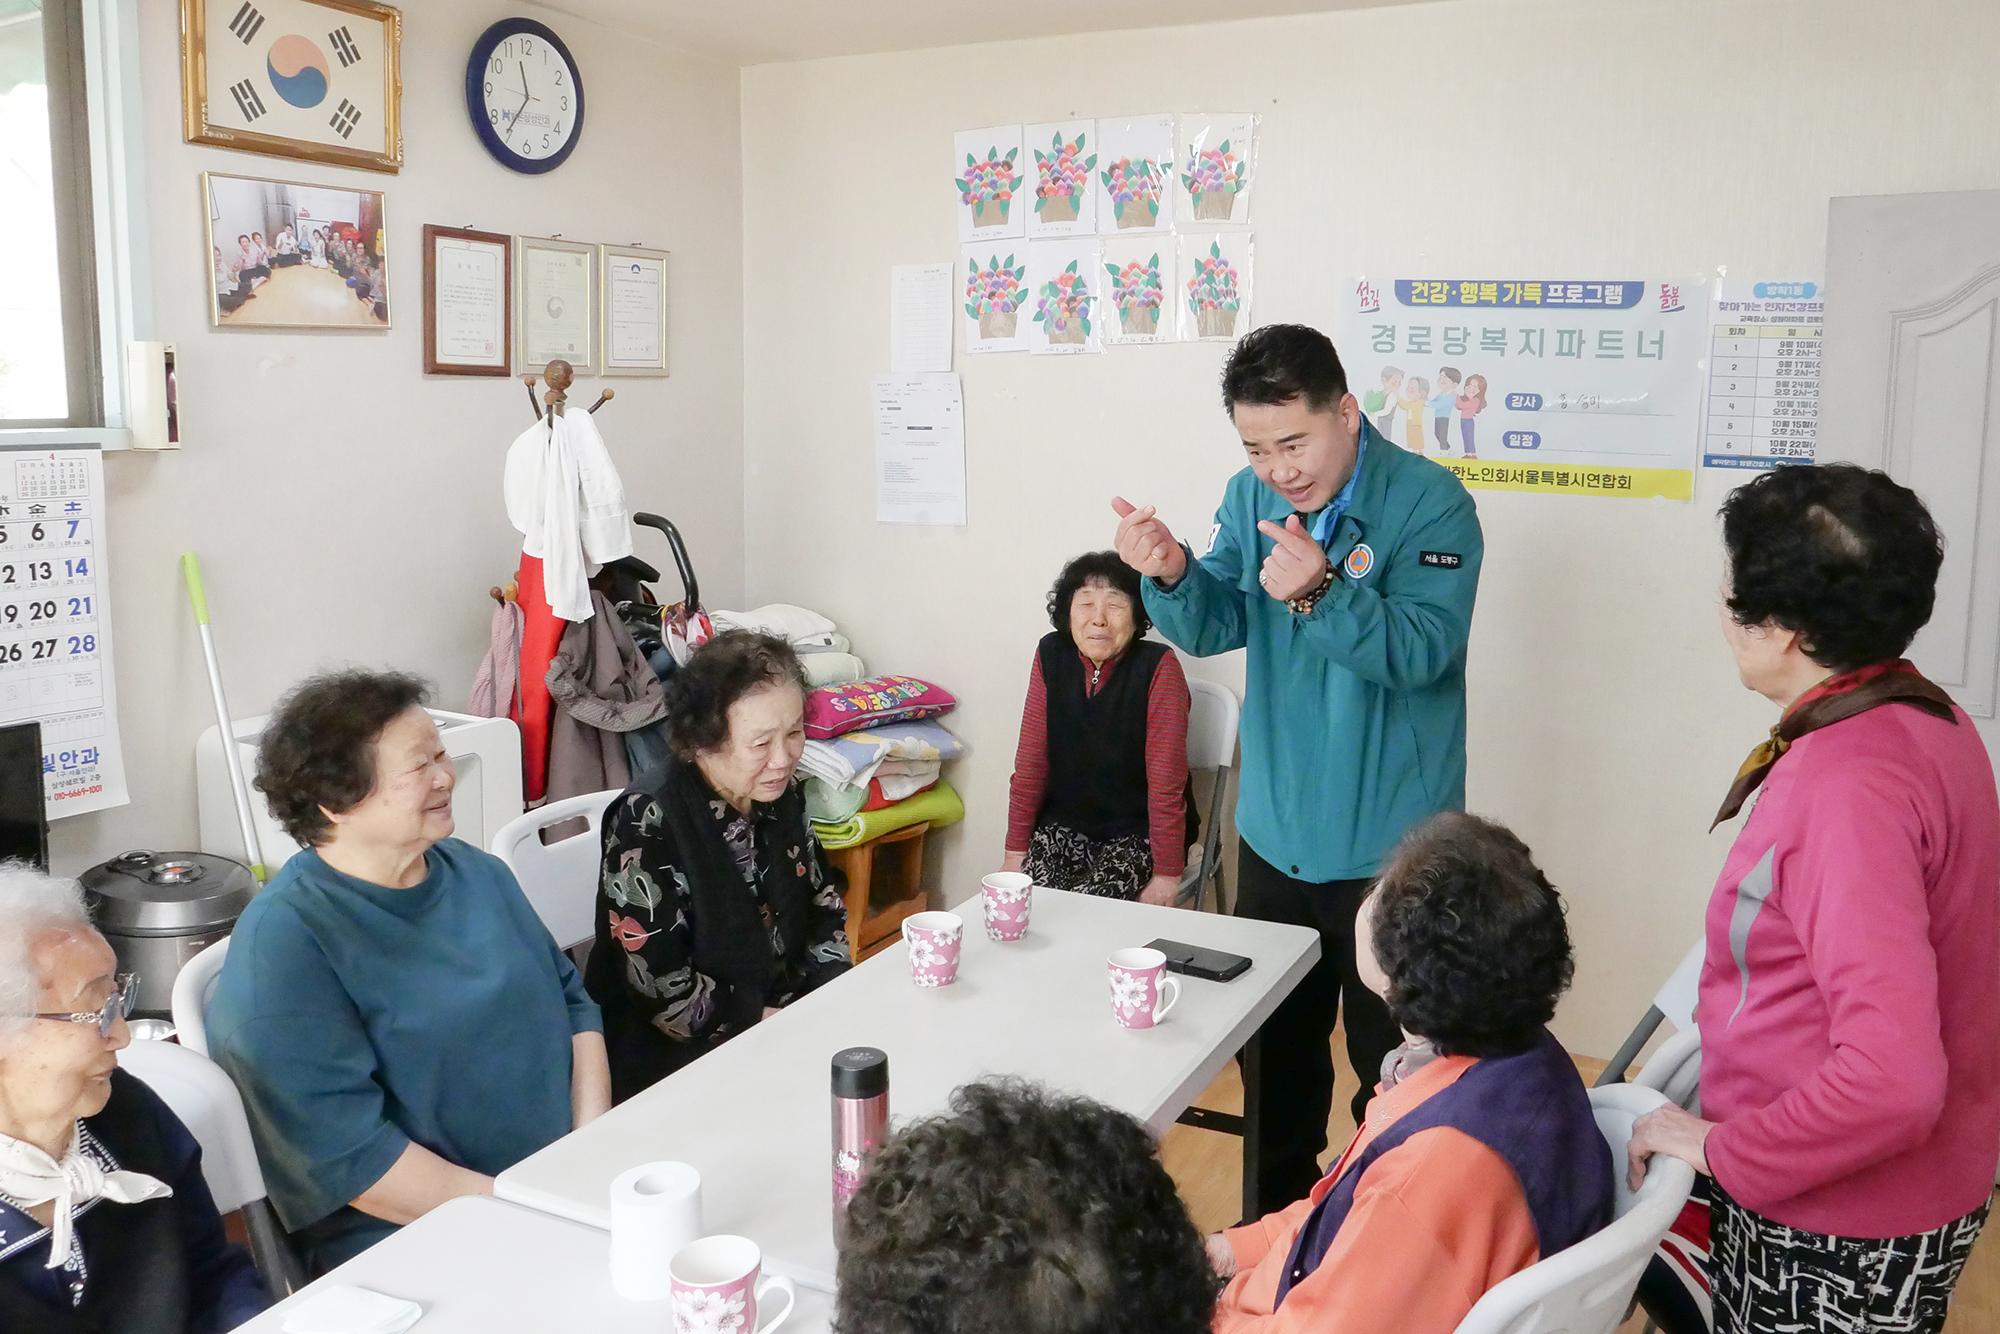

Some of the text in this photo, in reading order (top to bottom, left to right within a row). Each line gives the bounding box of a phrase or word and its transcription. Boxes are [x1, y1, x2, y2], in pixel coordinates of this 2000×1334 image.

[503, 41, 513, 58] 11
[520, 38, 533, 56] 12
[490, 56, 503, 74] 10
[555, 70, 562, 86] 2
[484, 82, 493, 97] 9
[560, 96, 568, 111] 3
[490, 109, 498, 125] 8
[506, 128, 513, 143] 7
[553, 121, 561, 135] 4
[522, 139, 531, 154] 6
[542, 134, 549, 149] 5
[1411, 282, 1623, 305] 건강·행복 가득 프로그램
[1718, 301, 1761, 312] 찾아가는
[1728, 328, 1746, 336] 회차
[1371, 325, 1665, 360] 경로당복지파트너
[1511, 395, 1537, 408] 강사
[1772, 408, 1789, 416] 오후
[1771, 428, 1788, 436] 오후
[1509, 434, 1534, 447] 일정
[1444, 465, 1632, 490] 한노인회서울특별시연합회
[28, 504, 46, 514] 金
[64, 501, 82, 512] 土
[31, 522, 45, 541] 6
[67, 520, 79, 538] 7
[1425, 554, 1458, 565] 서울 도봉구
[28, 561, 52, 581] 13
[65, 558, 88, 577] 14
[0, 596, 91, 624] 9 20 21
[0, 634, 96, 664] 26 27 28
[54, 784, 102, 801] 010-6669-1001
